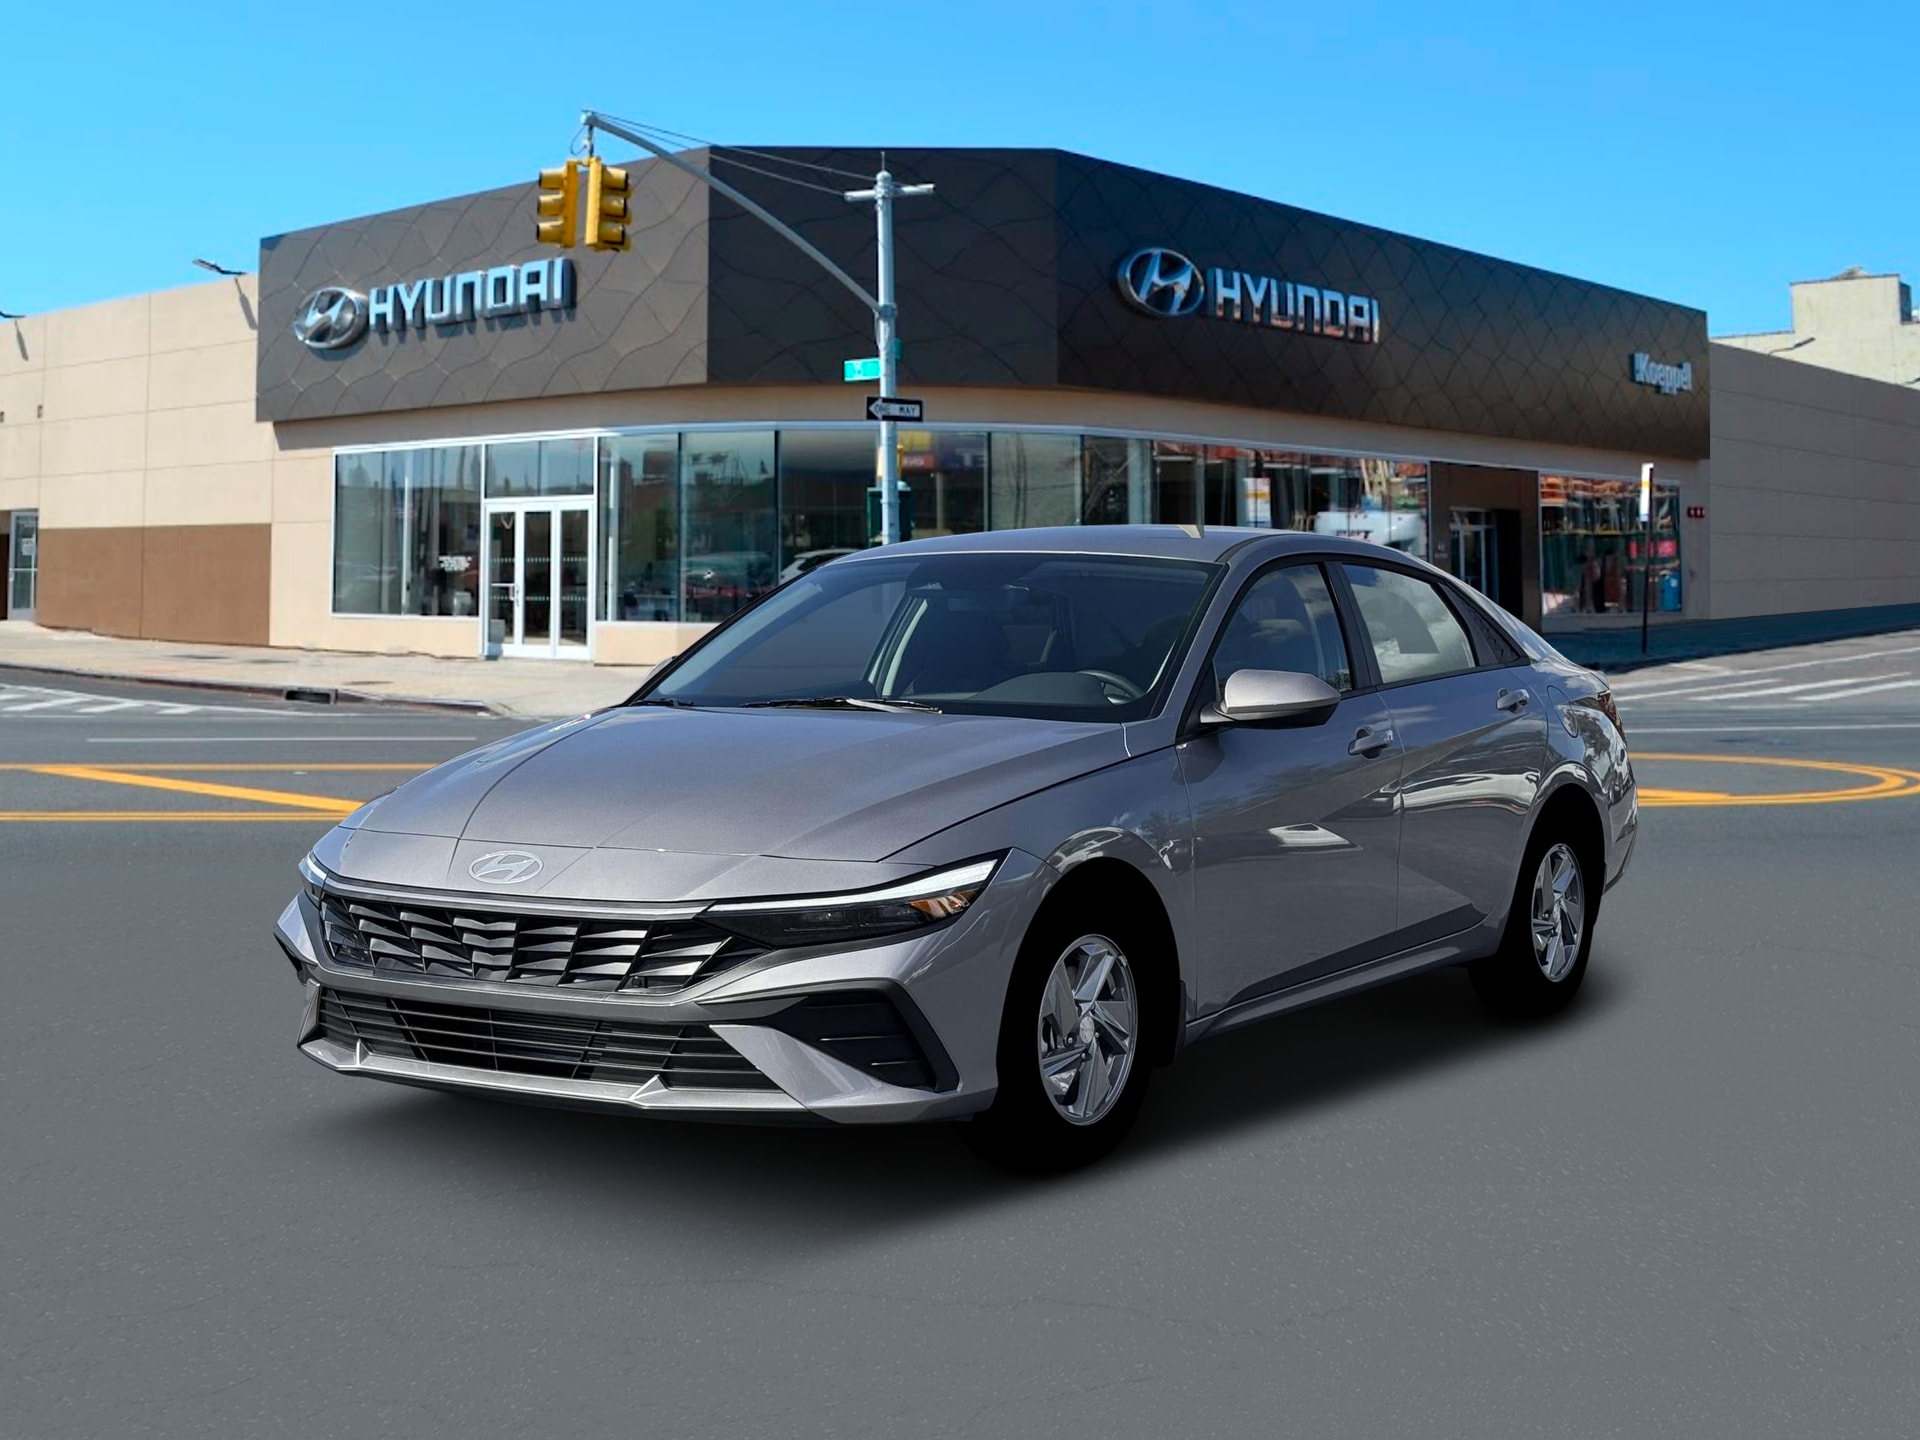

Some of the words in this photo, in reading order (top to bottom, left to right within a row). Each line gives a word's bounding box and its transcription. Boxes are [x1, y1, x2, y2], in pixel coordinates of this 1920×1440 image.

[368, 257, 576, 330] HYUNDAI
[1210, 266, 1380, 344] HYUNDAI
[874, 403, 890, 414] ONE
[899, 405, 917, 416] WAY
